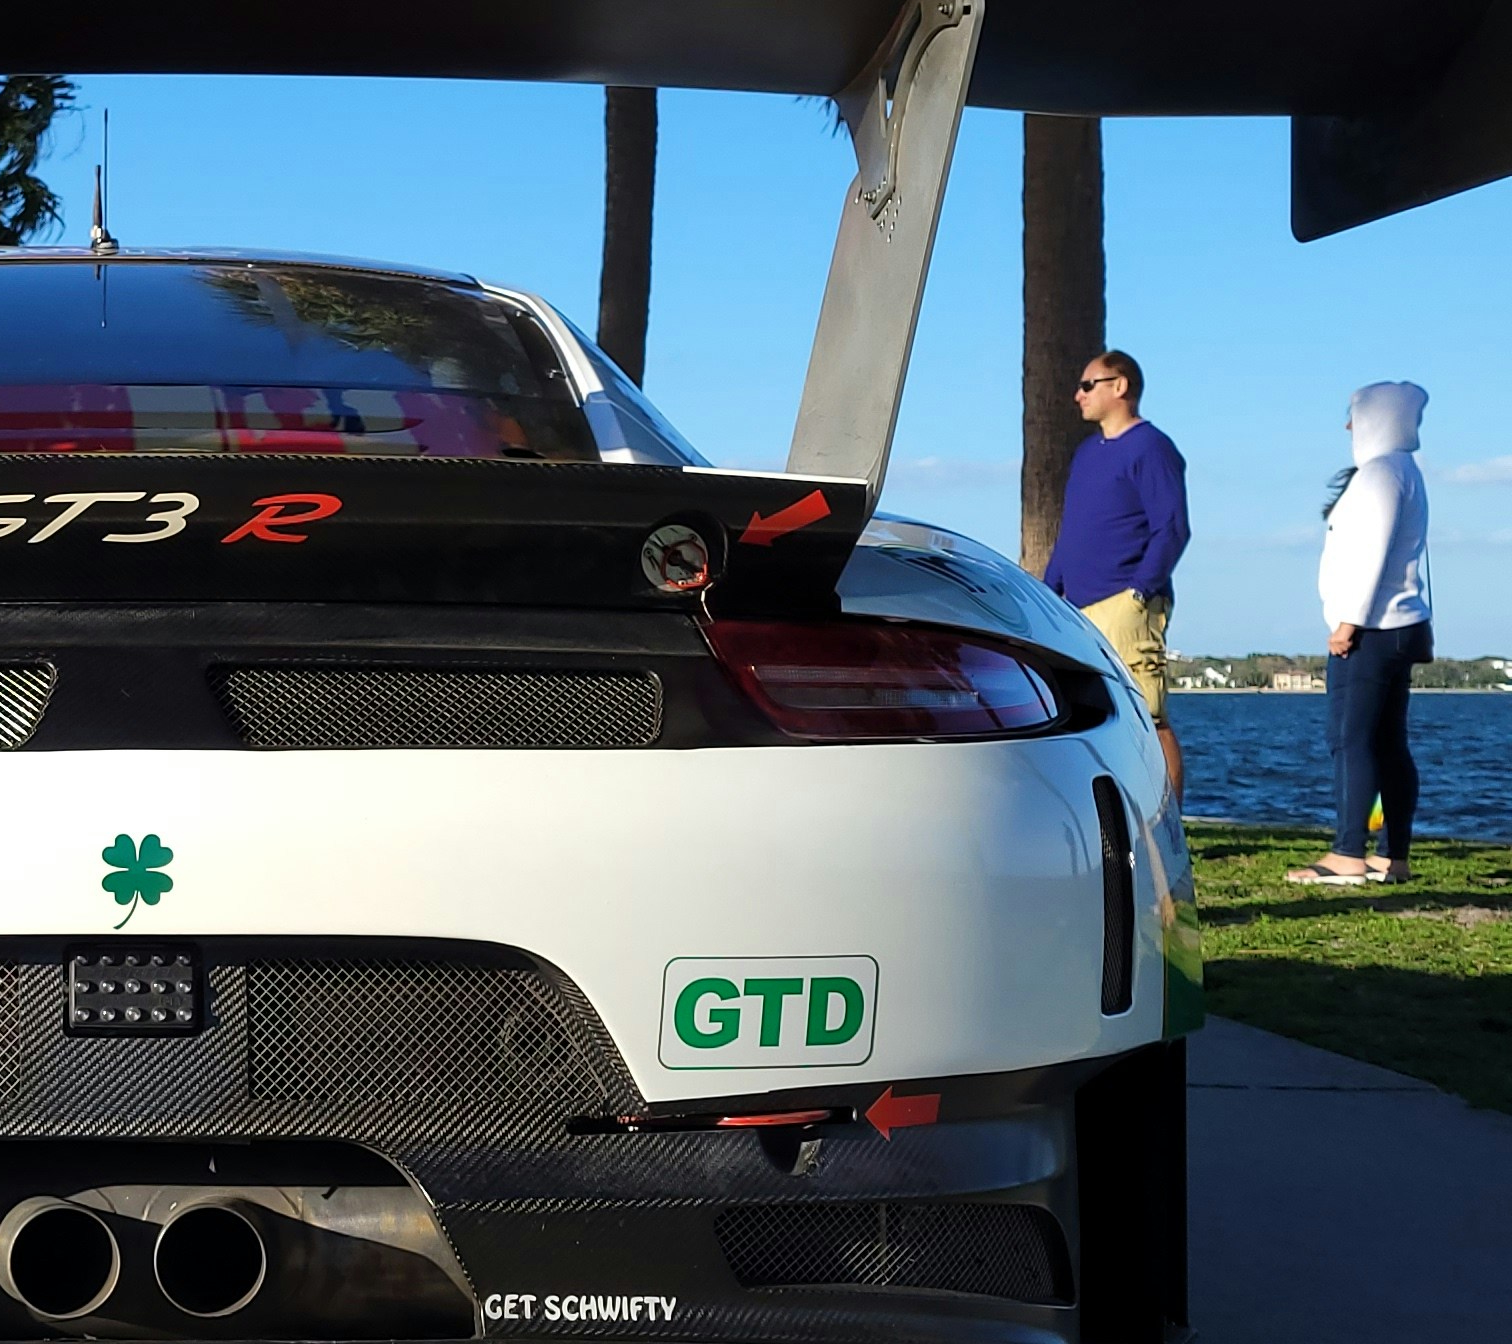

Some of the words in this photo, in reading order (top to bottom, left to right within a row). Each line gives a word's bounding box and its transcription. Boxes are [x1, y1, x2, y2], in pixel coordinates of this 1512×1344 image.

[221, 494, 343, 543] R
[674, 977, 864, 1048] GTD
[485, 1293, 536, 1320] GET
[544, 1294, 677, 1322] SCHWIFTY
